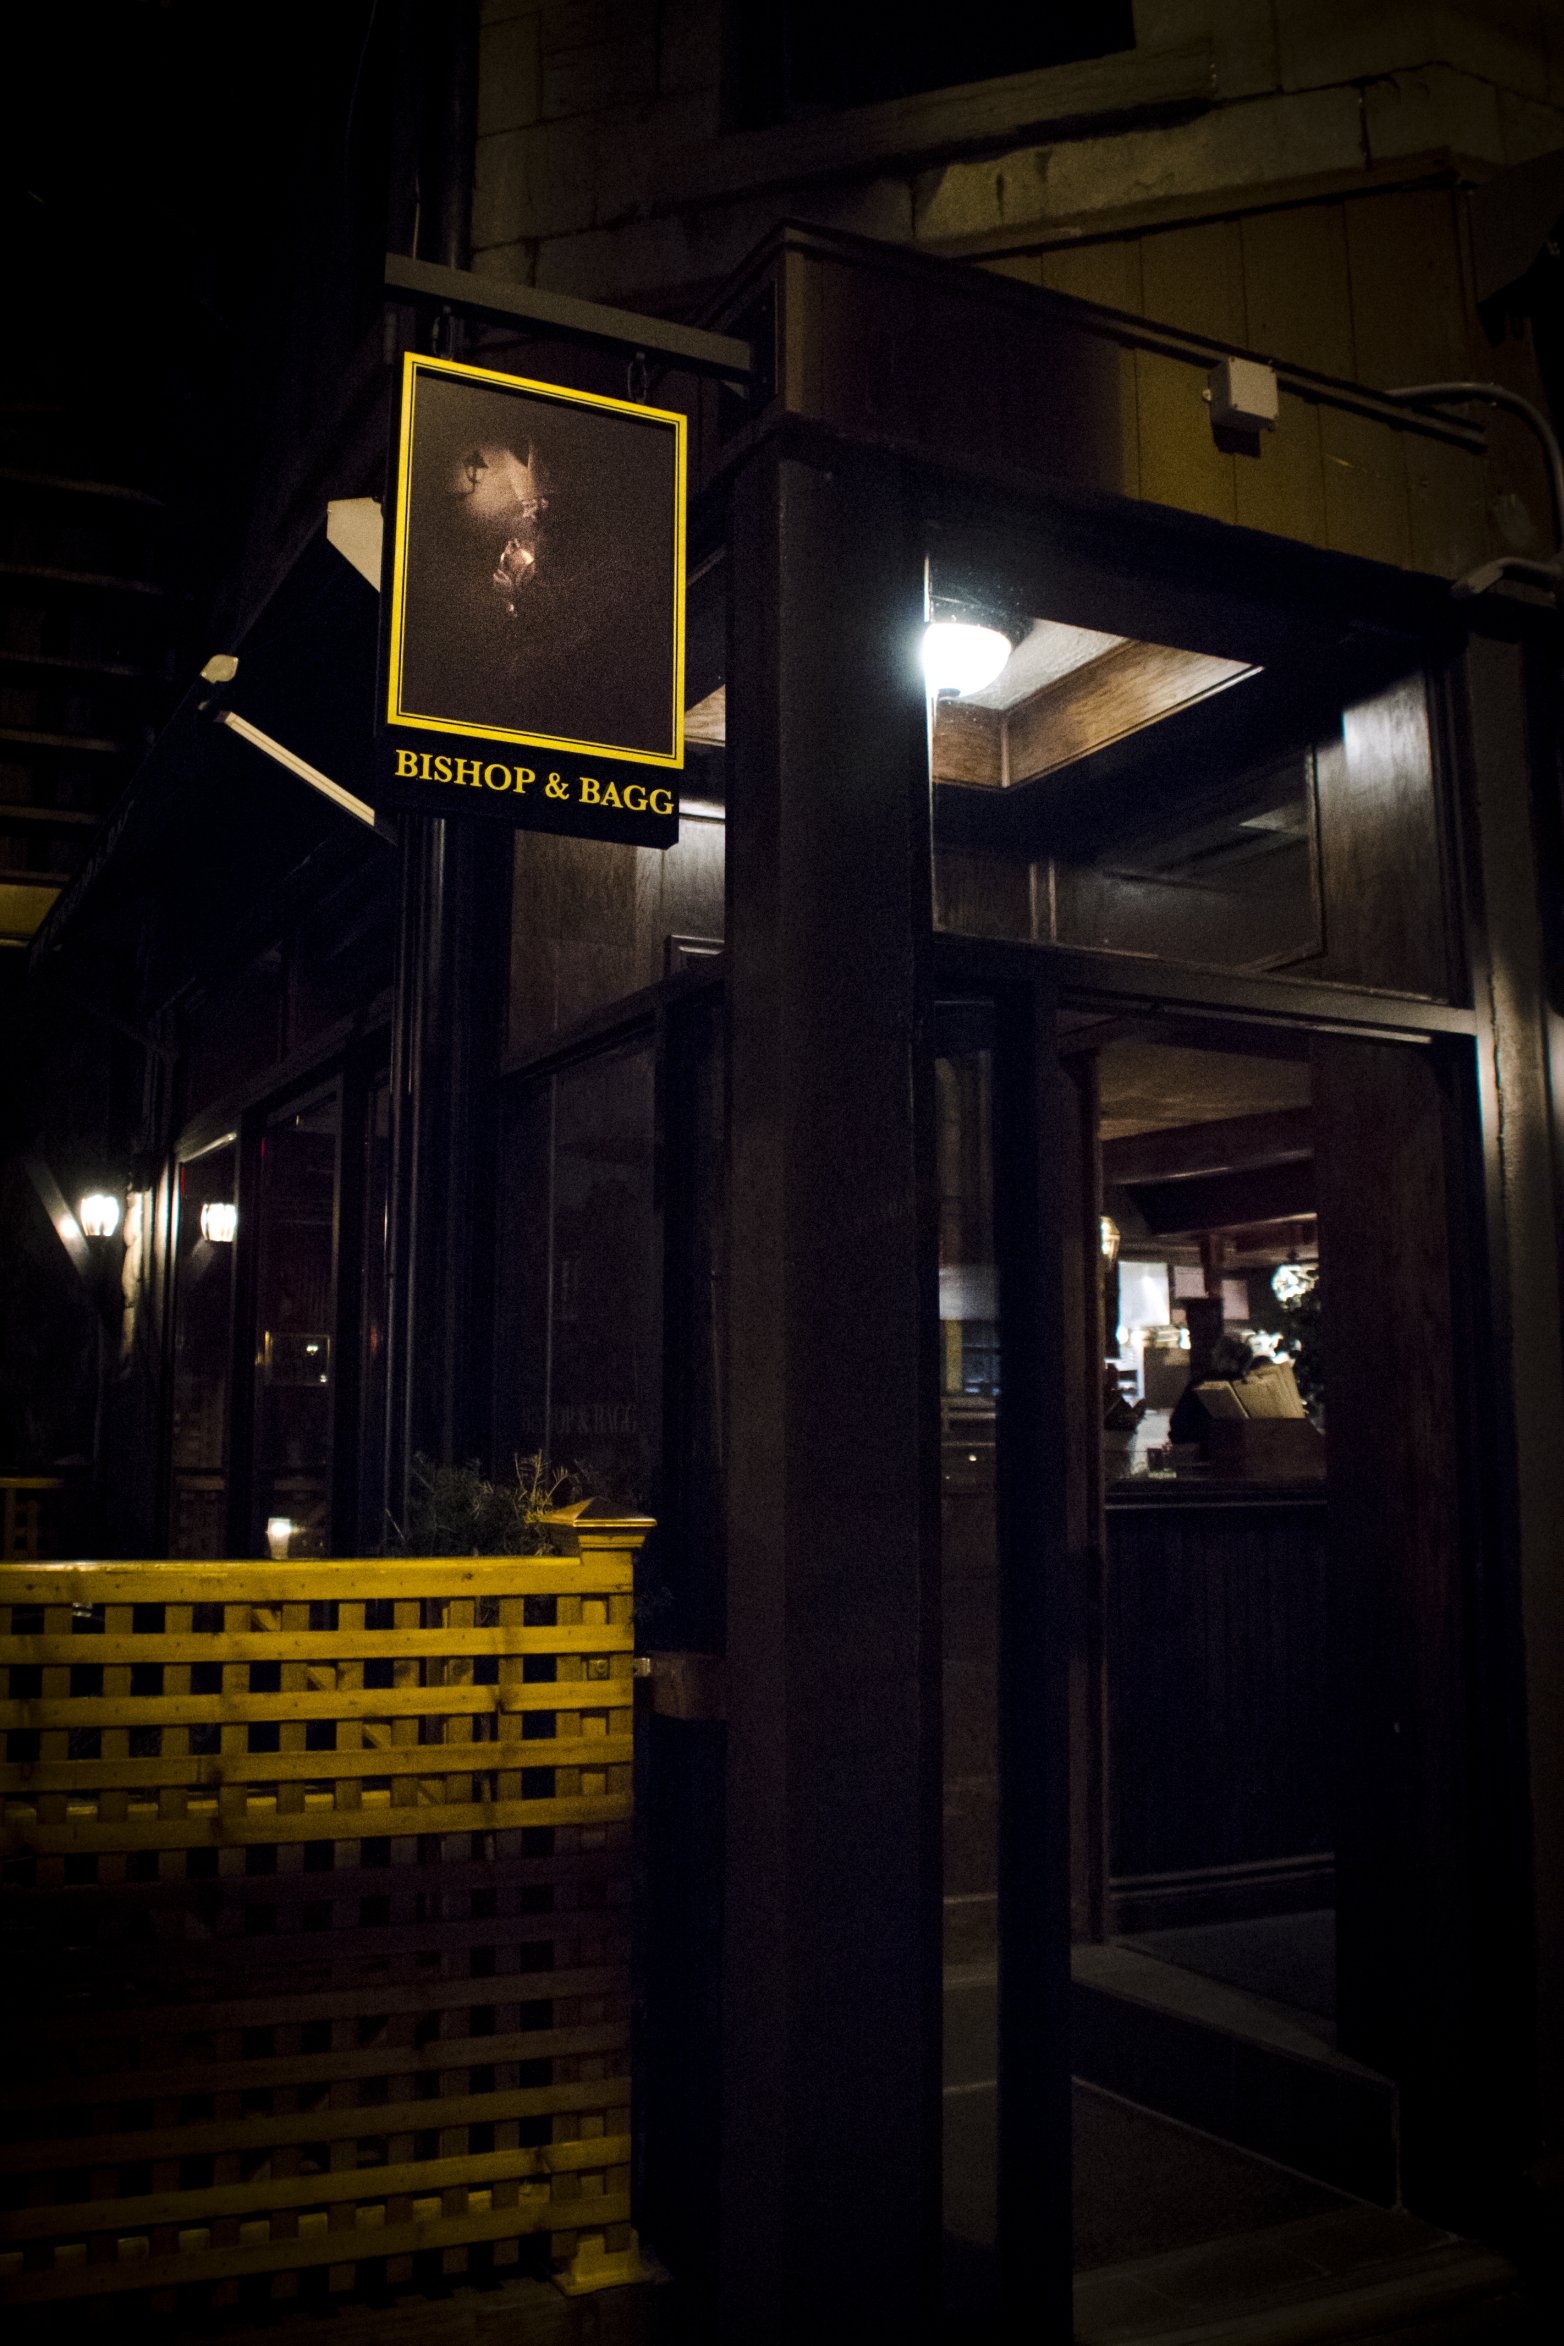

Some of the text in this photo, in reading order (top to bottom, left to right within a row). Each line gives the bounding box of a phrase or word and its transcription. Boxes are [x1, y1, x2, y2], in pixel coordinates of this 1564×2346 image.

[395, 748, 675, 815] BISHOP & BAGG
